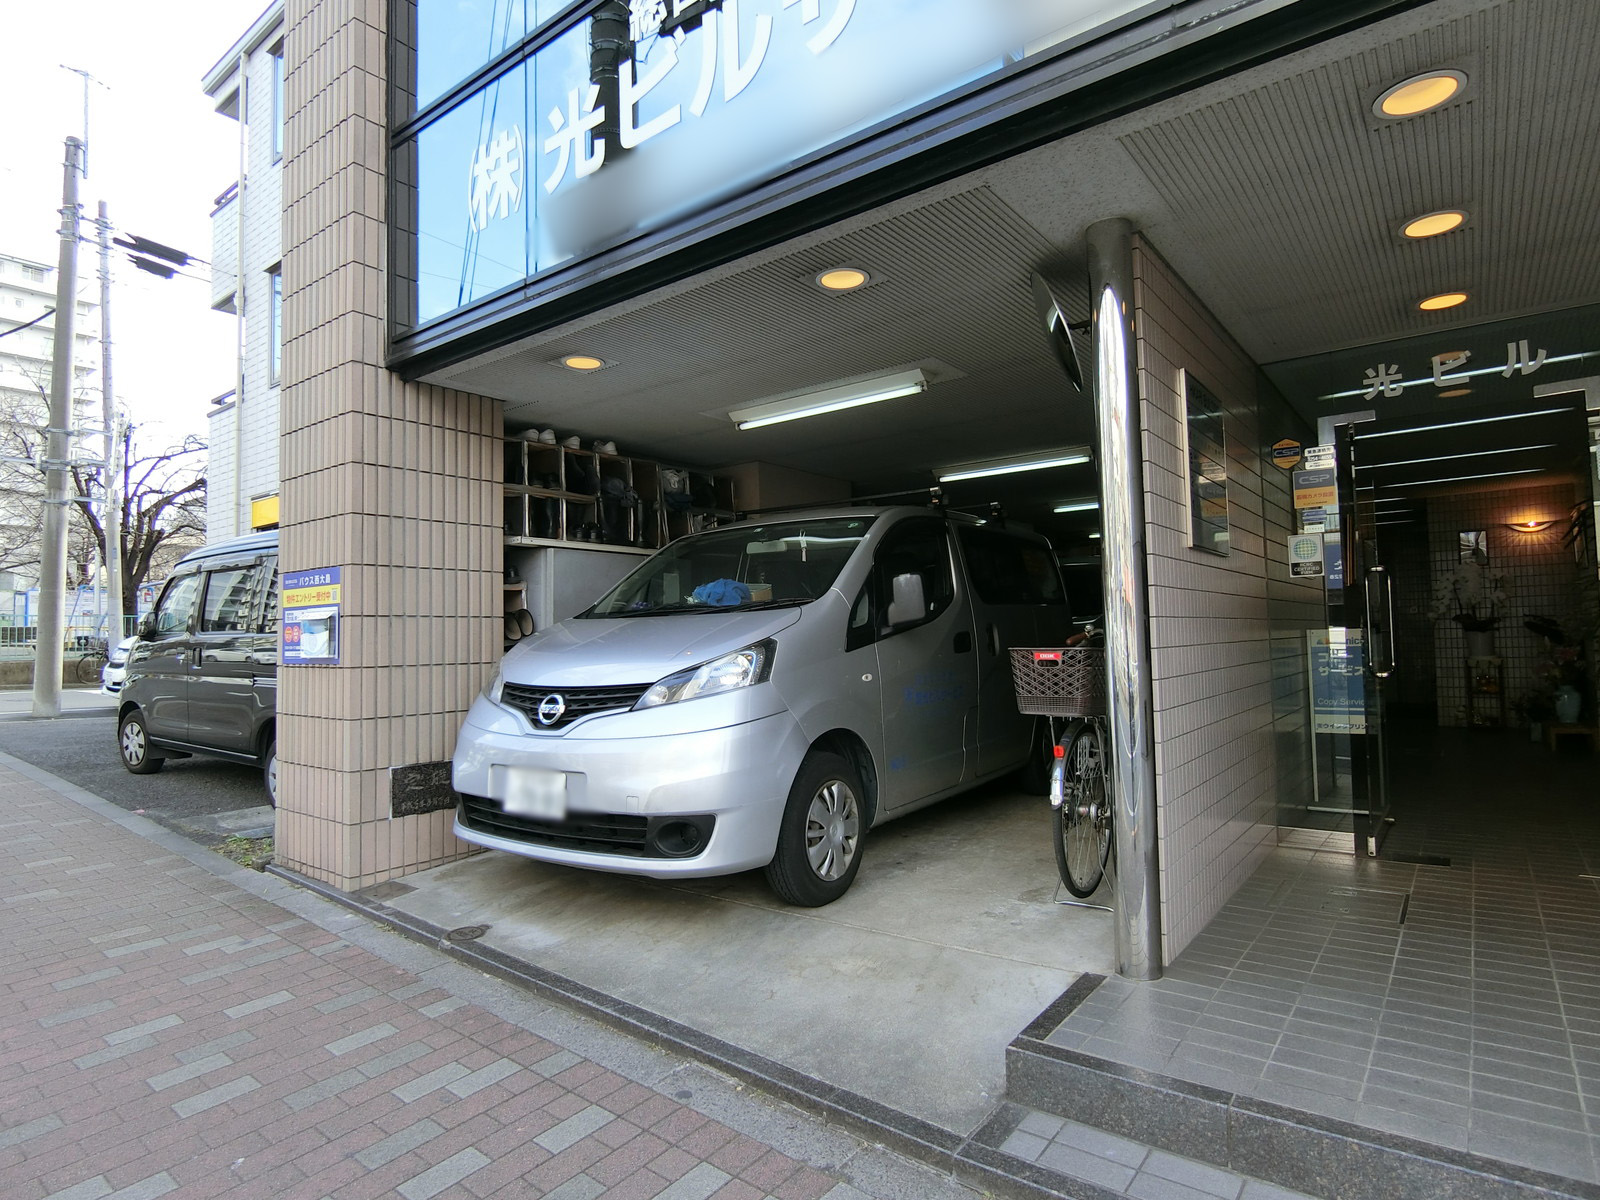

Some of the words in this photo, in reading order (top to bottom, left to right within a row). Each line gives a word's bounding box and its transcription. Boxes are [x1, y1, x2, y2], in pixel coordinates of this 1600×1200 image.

[1362, 339, 1548, 400] 光ビル
[1274, 447, 1299, 457] CSP
[1299, 474, 1330, 485] CSP
[1317, 697, 1338, 707] Copy
